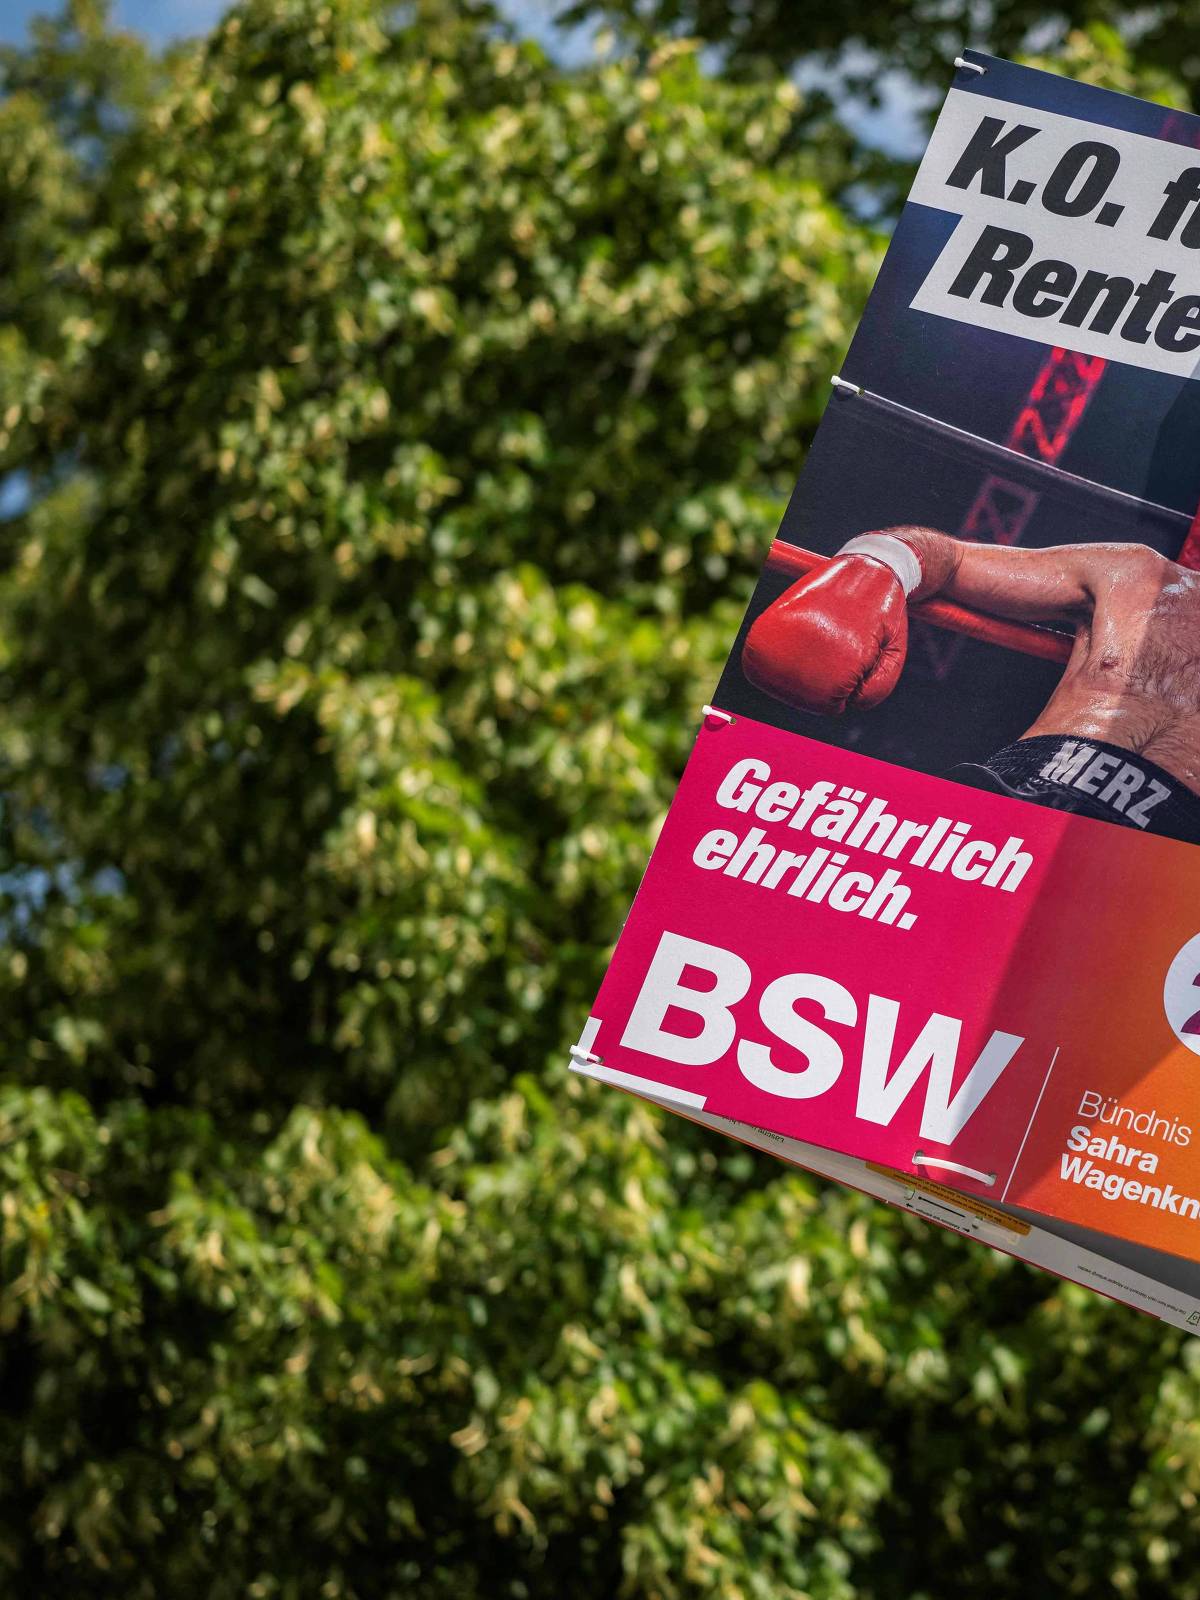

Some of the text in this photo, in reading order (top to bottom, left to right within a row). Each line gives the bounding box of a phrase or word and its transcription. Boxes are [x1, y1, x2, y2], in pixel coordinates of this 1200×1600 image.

[946, 115, 1125, 228] K.O.
[715, 758, 1033, 893] Gefährlich
[1039, 742, 1172, 829] MERZ
[692, 828, 918, 931] ehrlich.
[619, 930, 1026, 1146] BSW
[1066, 1125, 1159, 1174] Sahra
[1077, 1090, 1193, 1147] Bündnis
